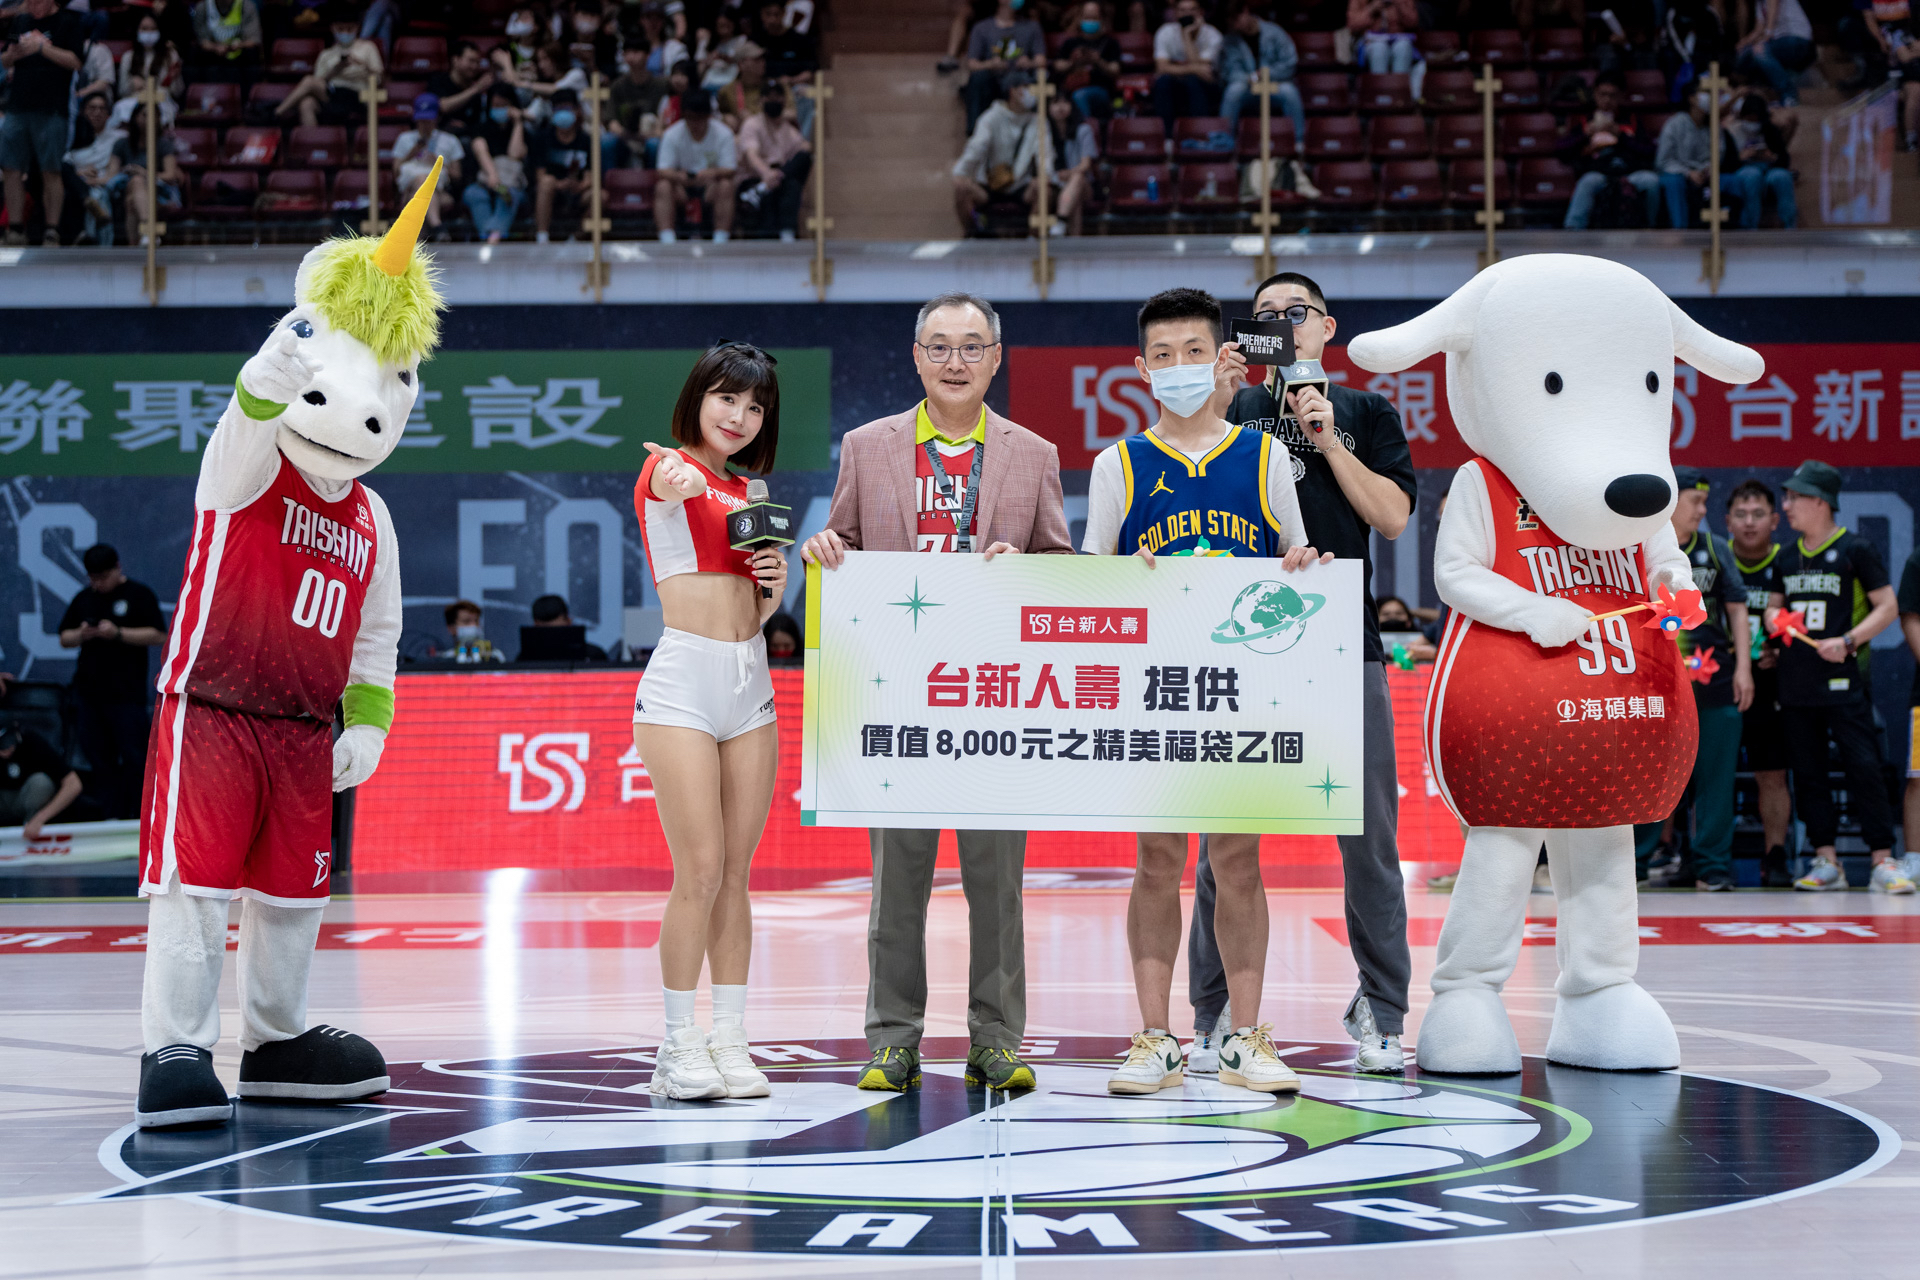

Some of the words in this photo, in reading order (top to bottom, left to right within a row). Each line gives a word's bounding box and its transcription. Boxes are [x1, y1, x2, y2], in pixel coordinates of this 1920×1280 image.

[1236, 332, 1283, 350] DREAMERS
[280, 495, 374, 584] TAISHIN
[1137, 509, 1201, 554] GOLDEN
[1207, 509, 1260, 553] STATE
[1517, 545, 1645, 597] TAISHIN
[1555, 586, 1629, 600] DREAMERS
[292, 568, 347, 639] 00
[1057, 614, 1140, 636] 台新人壽
[1575, 613, 1638, 677] 99
[926, 661, 1121, 711] 台新人壽
[1143, 665, 1240, 713] 提供
[1580, 695, 1666, 721] 海碩集團
[319, 1182, 1640, 1249] DREAMERS
